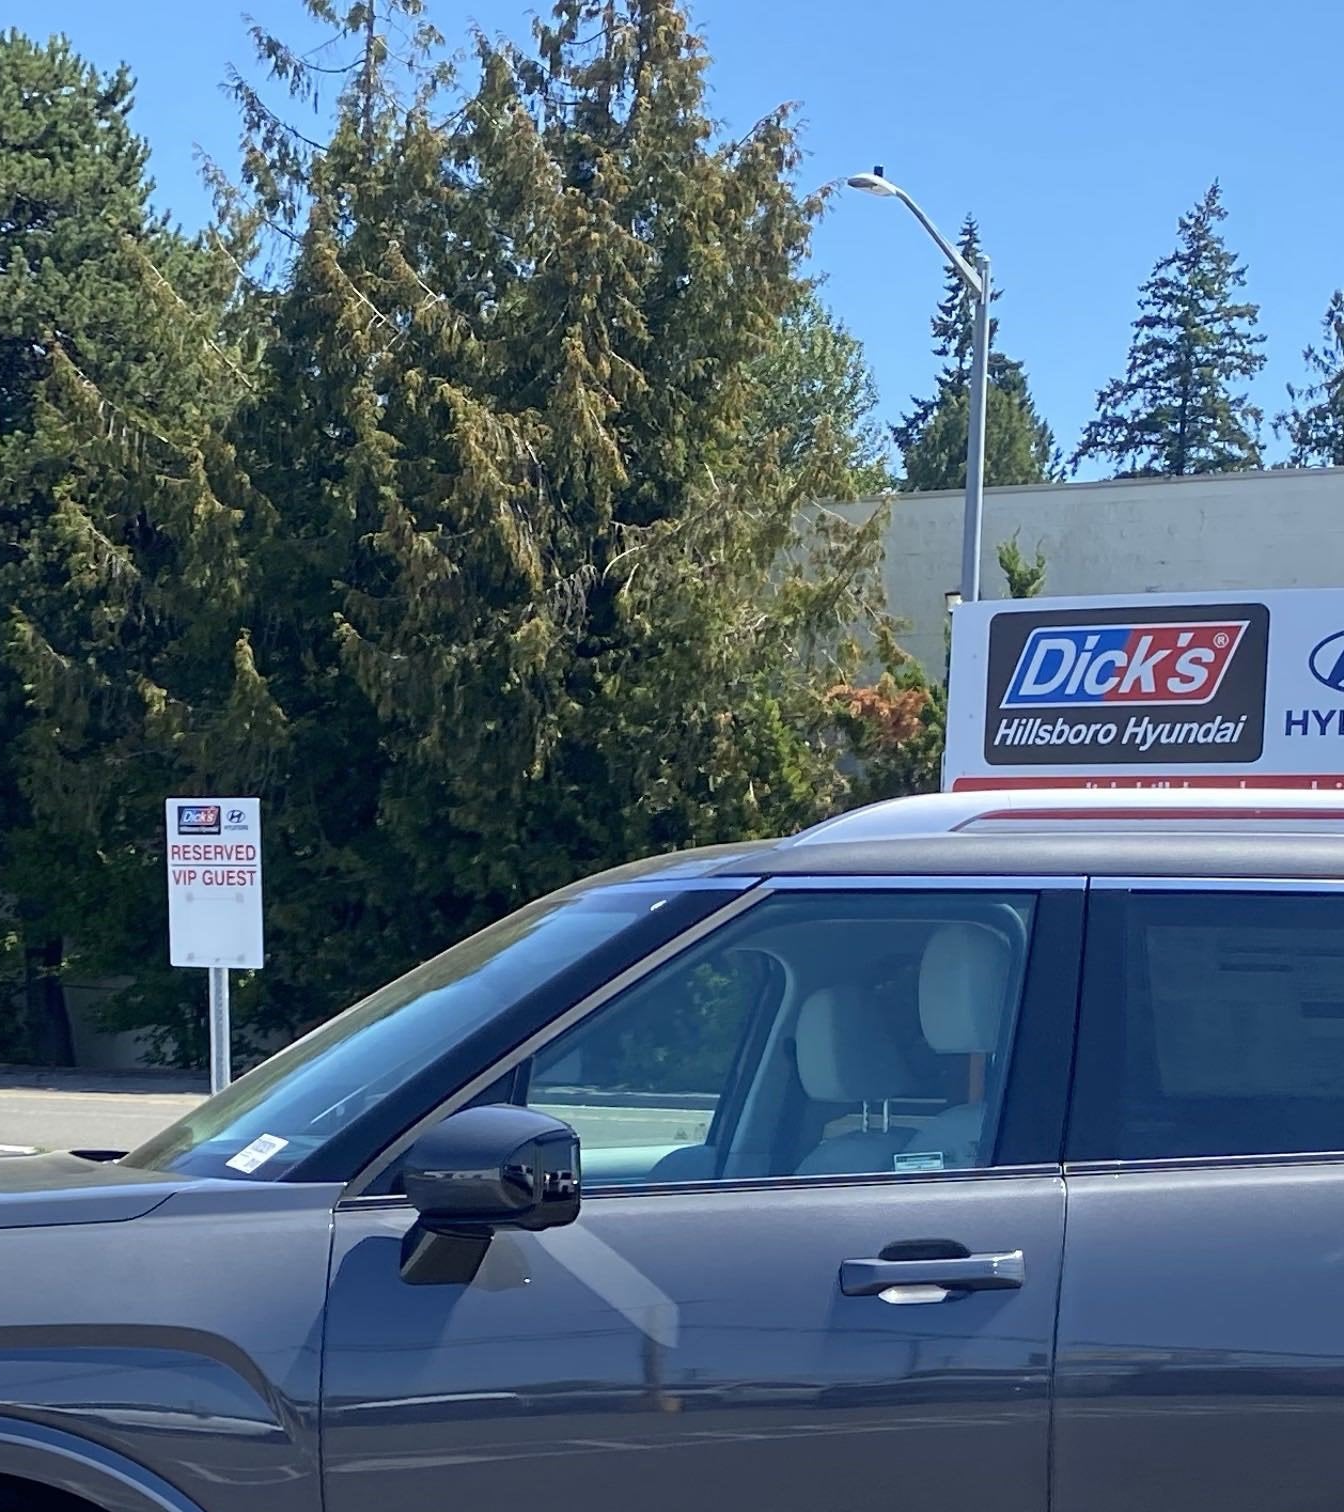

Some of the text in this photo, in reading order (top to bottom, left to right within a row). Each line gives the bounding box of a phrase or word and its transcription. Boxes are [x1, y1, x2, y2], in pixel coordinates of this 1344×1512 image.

[1018, 632, 1215, 696] Dick's
[993, 714, 1248, 751] Hillsboro Hyundai
[170, 844, 257, 861] RESERVED
[172, 869, 257, 887] VIP GUEST
